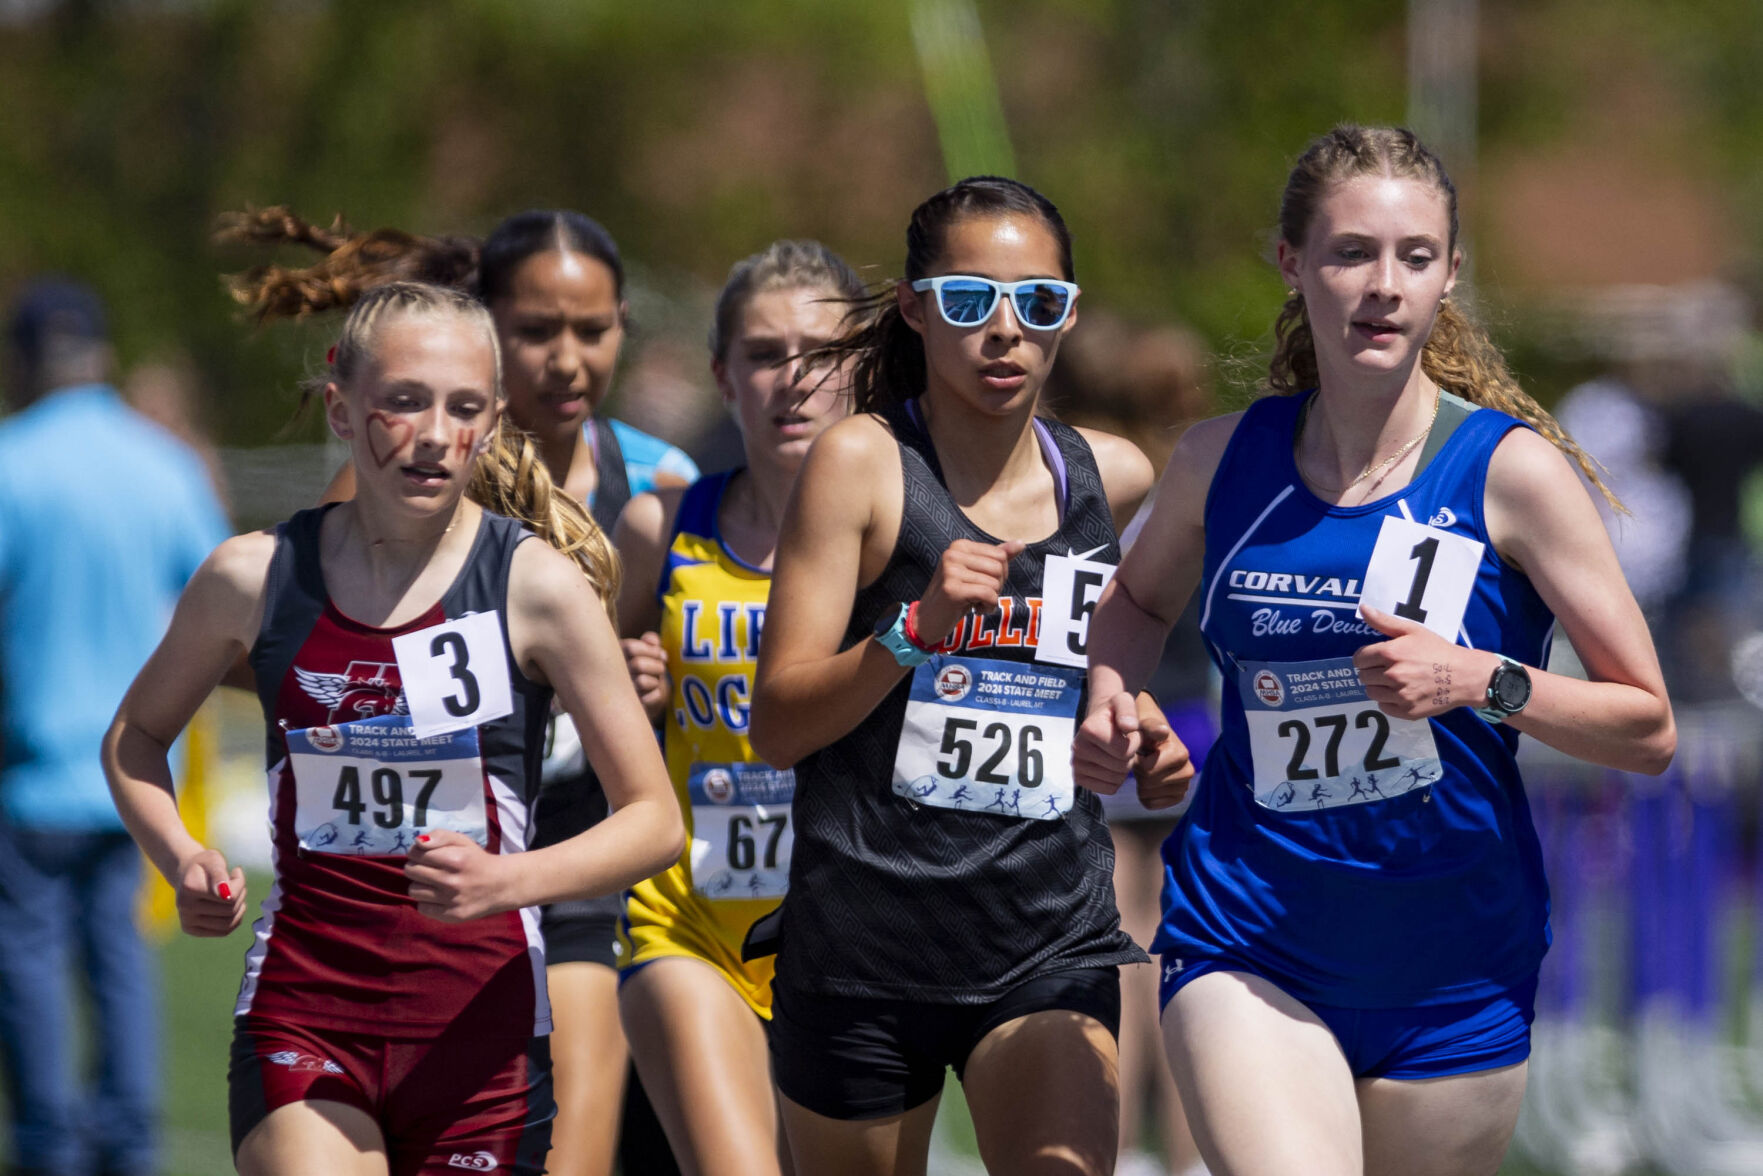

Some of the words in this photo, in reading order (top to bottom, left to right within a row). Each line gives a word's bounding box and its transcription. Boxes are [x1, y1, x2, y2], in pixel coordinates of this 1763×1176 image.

[1229, 570, 1362, 598] CORVAL
[1394, 536, 1440, 624] 1
[1066, 569, 1104, 656] 5
[1251, 608, 1302, 637] Blue
[429, 631, 481, 718] 3
[981, 670, 1014, 683] TRACK
[1014, 674, 1037, 686] AND
[1037, 676, 1067, 689] FIELD
[1286, 671, 1325, 683] TRACK
[1327, 668, 1352, 679] AND
[1290, 682, 1320, 694] 2024
[1321, 679, 1356, 690] STATE
[1003, 685, 1033, 698] STATE
[1034, 688, 1063, 700] MEET
[348, 724, 388, 736] TRACK
[350, 737, 379, 747] 2024
[381, 738, 418, 748] STATE
[421, 735, 453, 746] MEET
[935, 717, 1044, 789] 526
[1278, 709, 1401, 782] 272
[332, 765, 443, 829] 497
[726, 814, 788, 872] 67
[448, 1152, 484, 1169] PCS
